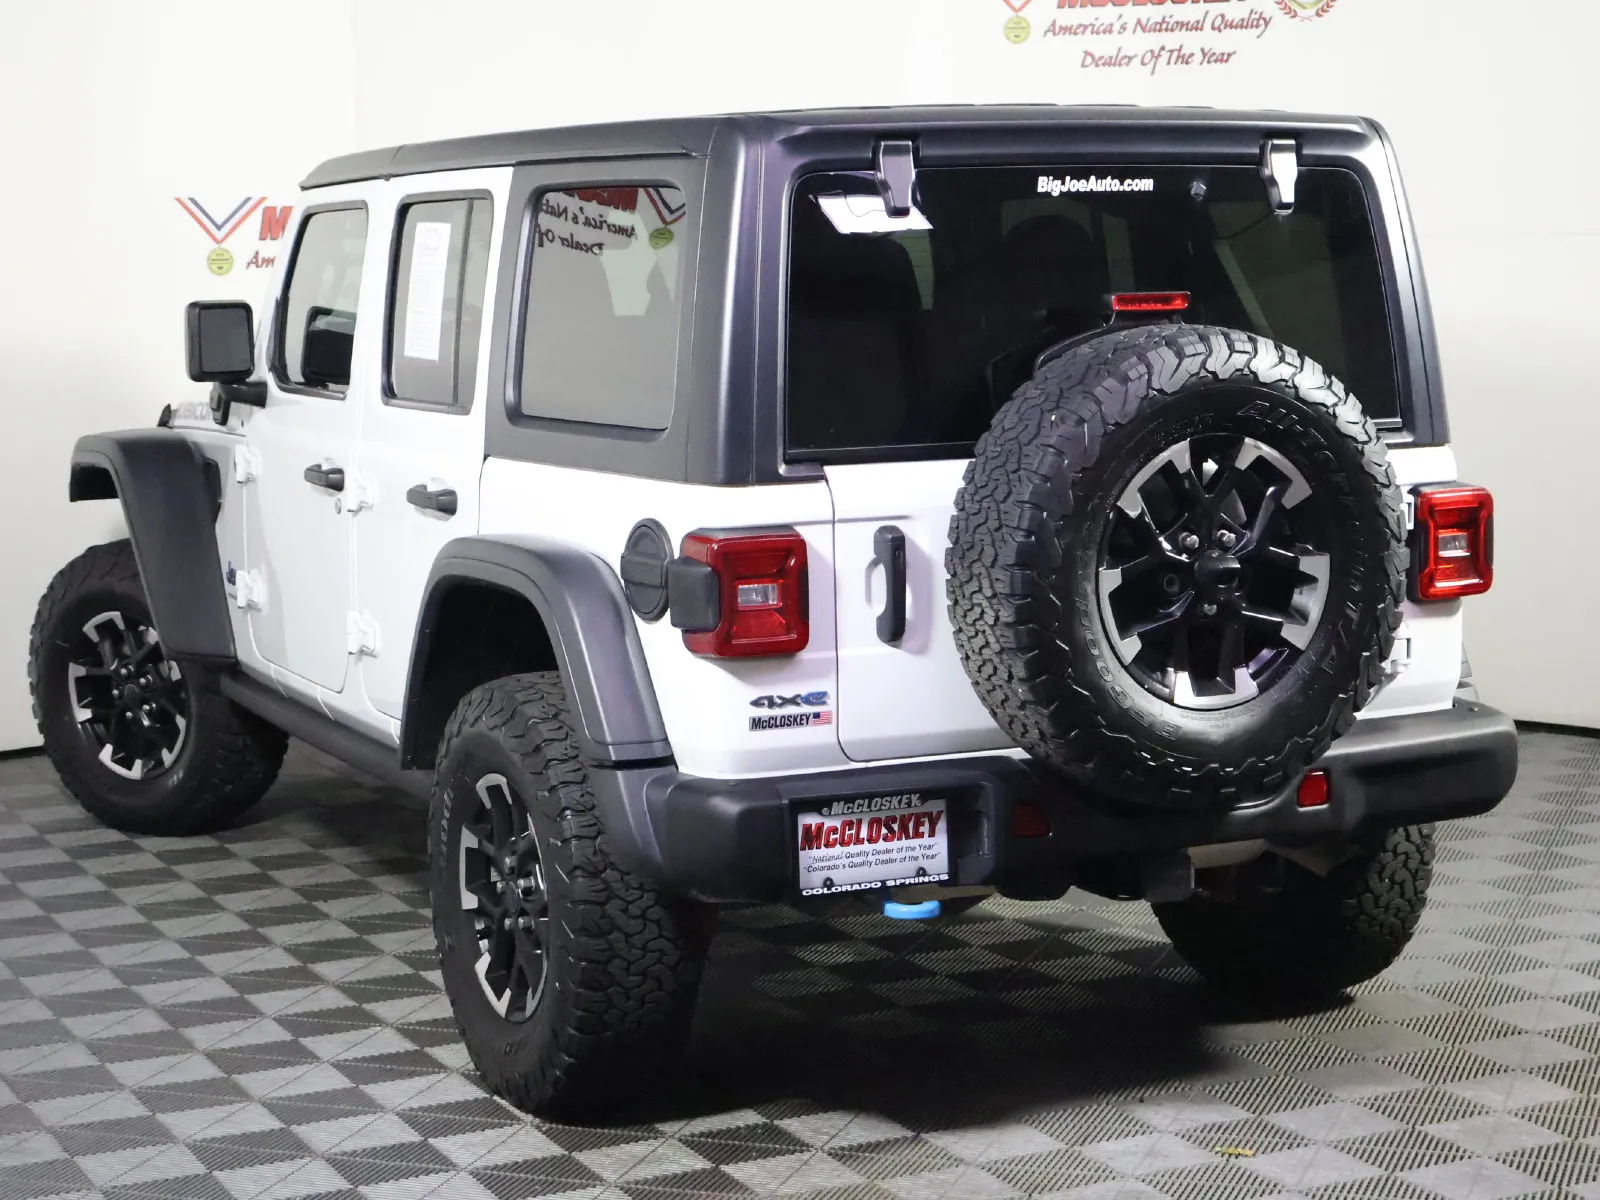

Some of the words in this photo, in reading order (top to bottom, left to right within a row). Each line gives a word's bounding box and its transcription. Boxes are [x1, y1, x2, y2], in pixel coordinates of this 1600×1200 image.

[1043, 14, 1127, 37] America's
[1133, 10, 1208, 35] National
[1211, 9, 1272, 39] Quality
[1081, 47, 1137, 68] Dealer
[1140, 45, 1165, 76] Of
[1164, 44, 1195, 66] The
[1199, 47, 1236, 66] Year
[1037, 176, 1153, 196] BigJoeAuto.com
[751, 713, 812, 730] McCLOSKEY
[830, 793, 922, 816] McCLOSKEY
[800, 810, 944, 852] McCLOSKEY
[845, 849, 870, 859] Quality
[872, 848, 894, 856] Dealer
[896, 846, 904, 854] of
[848, 860, 873, 869] Quality
[874, 858, 897, 866] Dealer
[802, 881, 882, 896] COLORADO
[885, 873, 950, 888] SPRINGS
